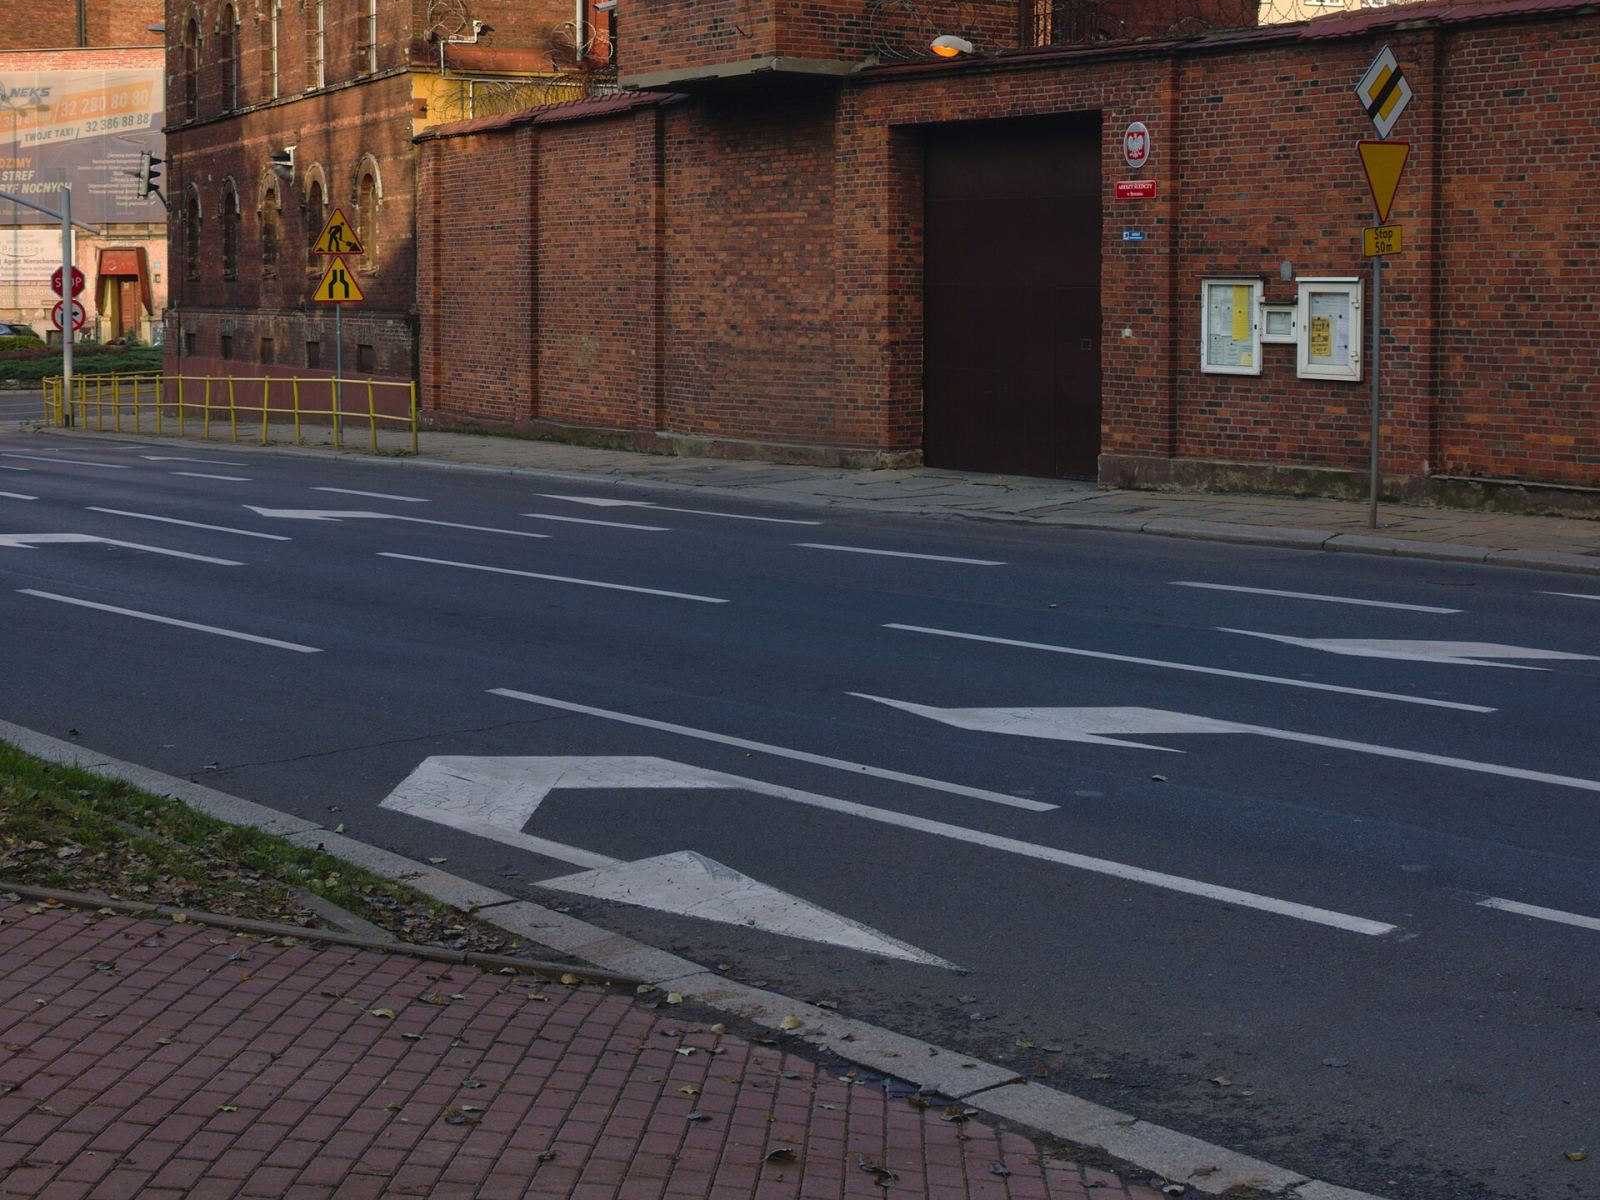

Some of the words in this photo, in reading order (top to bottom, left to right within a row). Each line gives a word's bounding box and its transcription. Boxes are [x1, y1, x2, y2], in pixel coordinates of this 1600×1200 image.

[10, 87, 51, 97] NEKS
[61, 102, 77, 117] 32
[81, 96, 106, 114] 280
[111, 92, 129, 108] 80
[132, 89, 149, 105] 80
[85, 121, 97, 133] 32
[100, 118, 119, 131] 386
[121, 116, 134, 127] 88
[137, 113, 149, 125] 88
[25, 130, 52, 142] TWOJE
[55, 127, 74, 138] TAXI
[2, 170, 35, 181] STREF
[1374, 228, 1393, 241] Stop
[1375, 241, 1393, 253] 50m
[55, 277, 82, 288] SP
